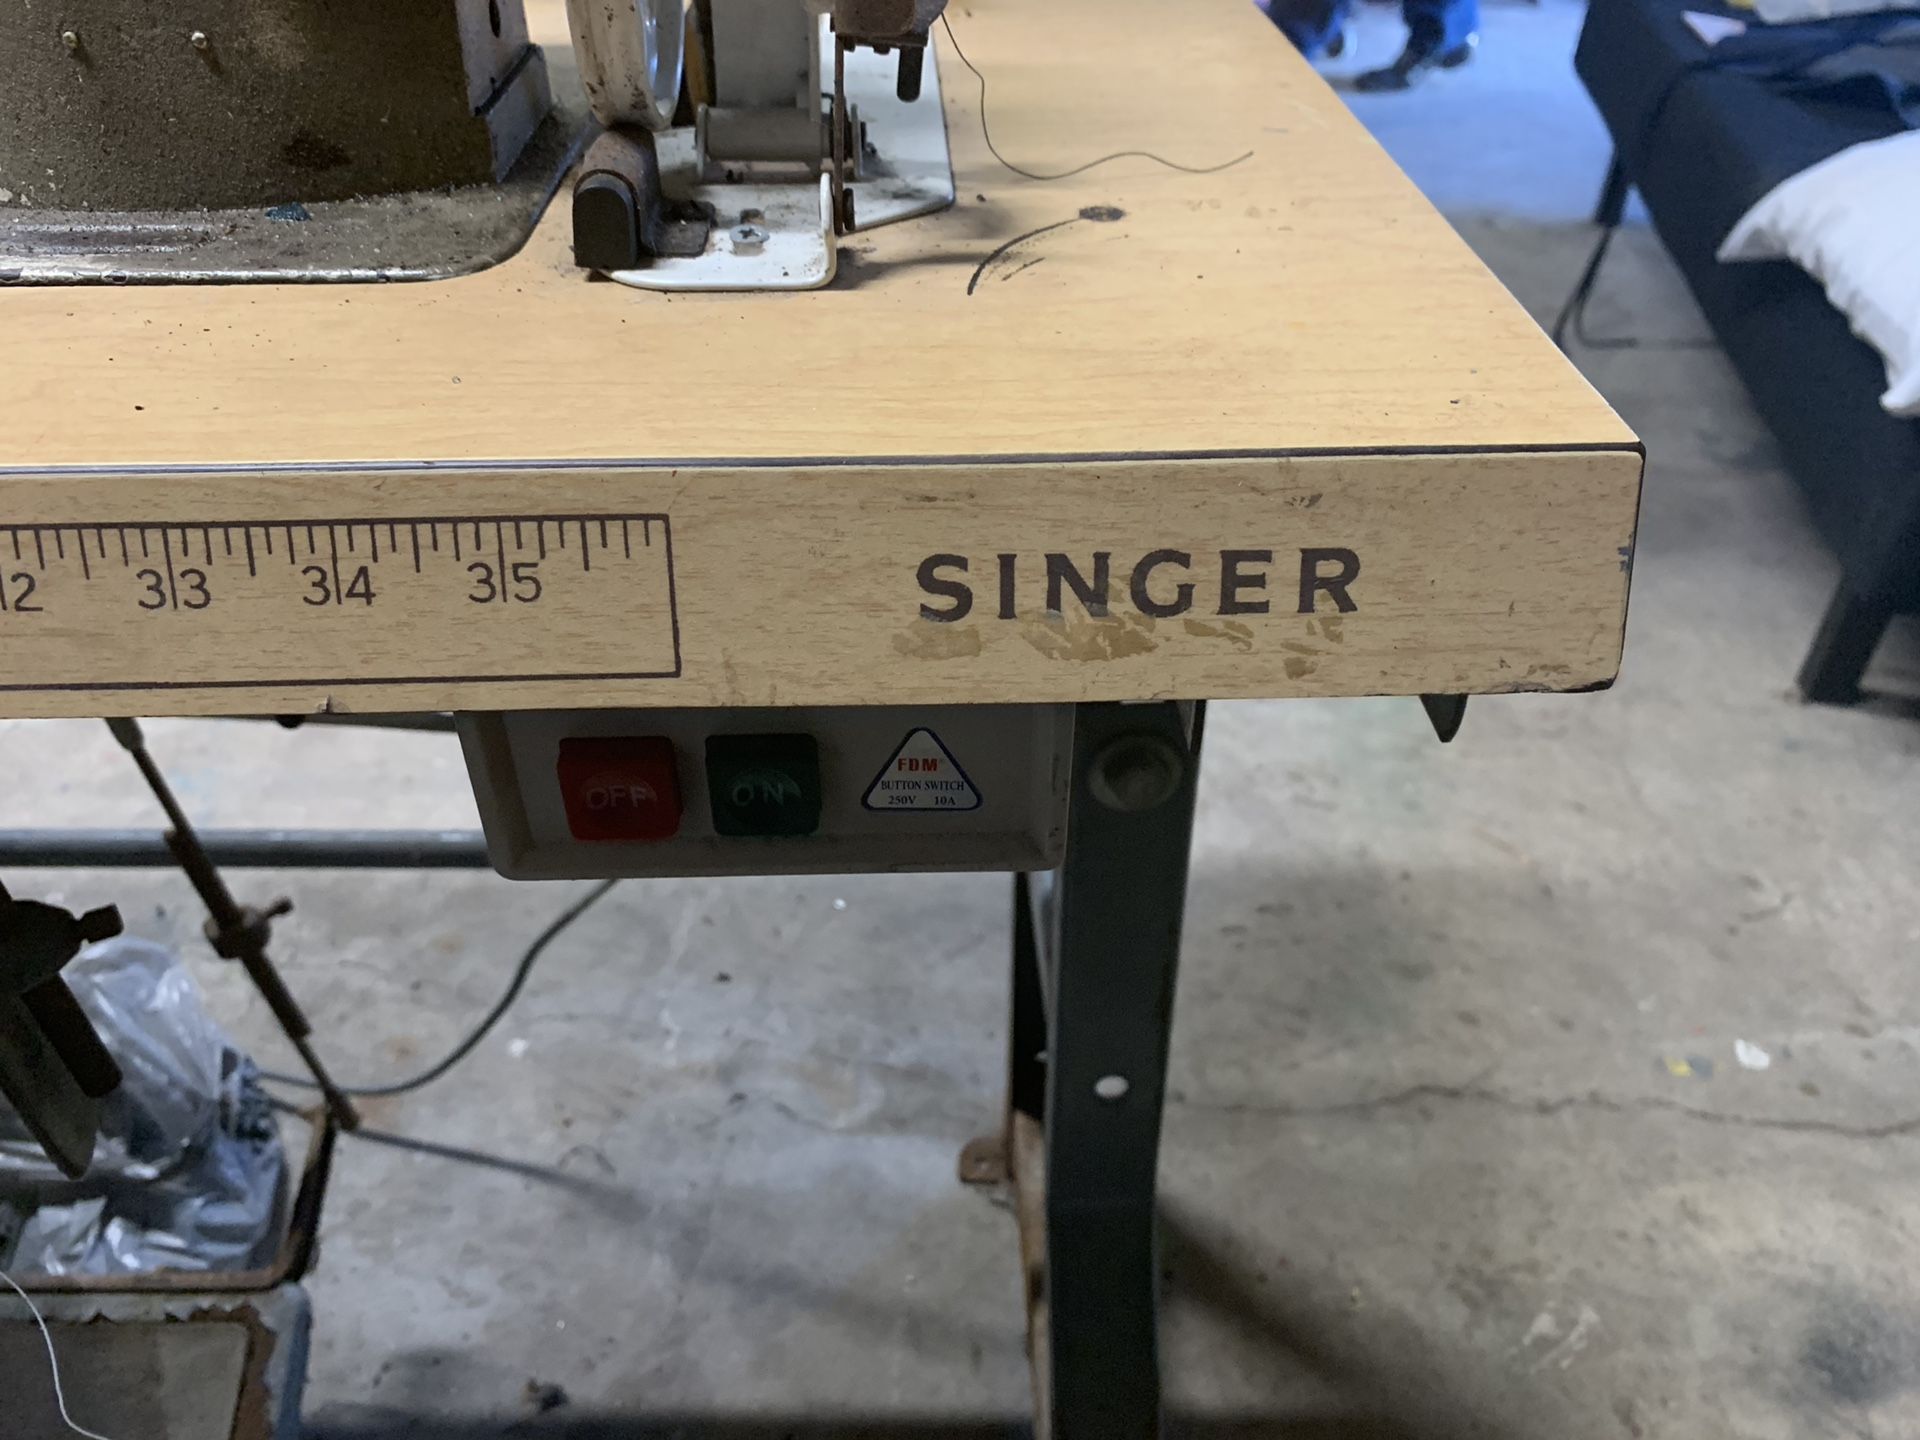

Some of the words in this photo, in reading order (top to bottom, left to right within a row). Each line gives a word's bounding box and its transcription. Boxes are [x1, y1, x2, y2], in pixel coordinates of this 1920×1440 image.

[136, 567, 212, 610] 33
[301, 563, 377, 607] 34
[466, 561, 543, 604] 35
[916, 548, 1361, 622] SINGER
[897, 758, 939, 772] FDM
[585, 784, 649, 811] OFF
[731, 781, 786, 808] ON
[881, 780, 922, 791] BUTTON
[924, 781, 965, 792] SWITCH
[888, 795, 917, 806] 250V
[934, 796, 957, 806] 10A
